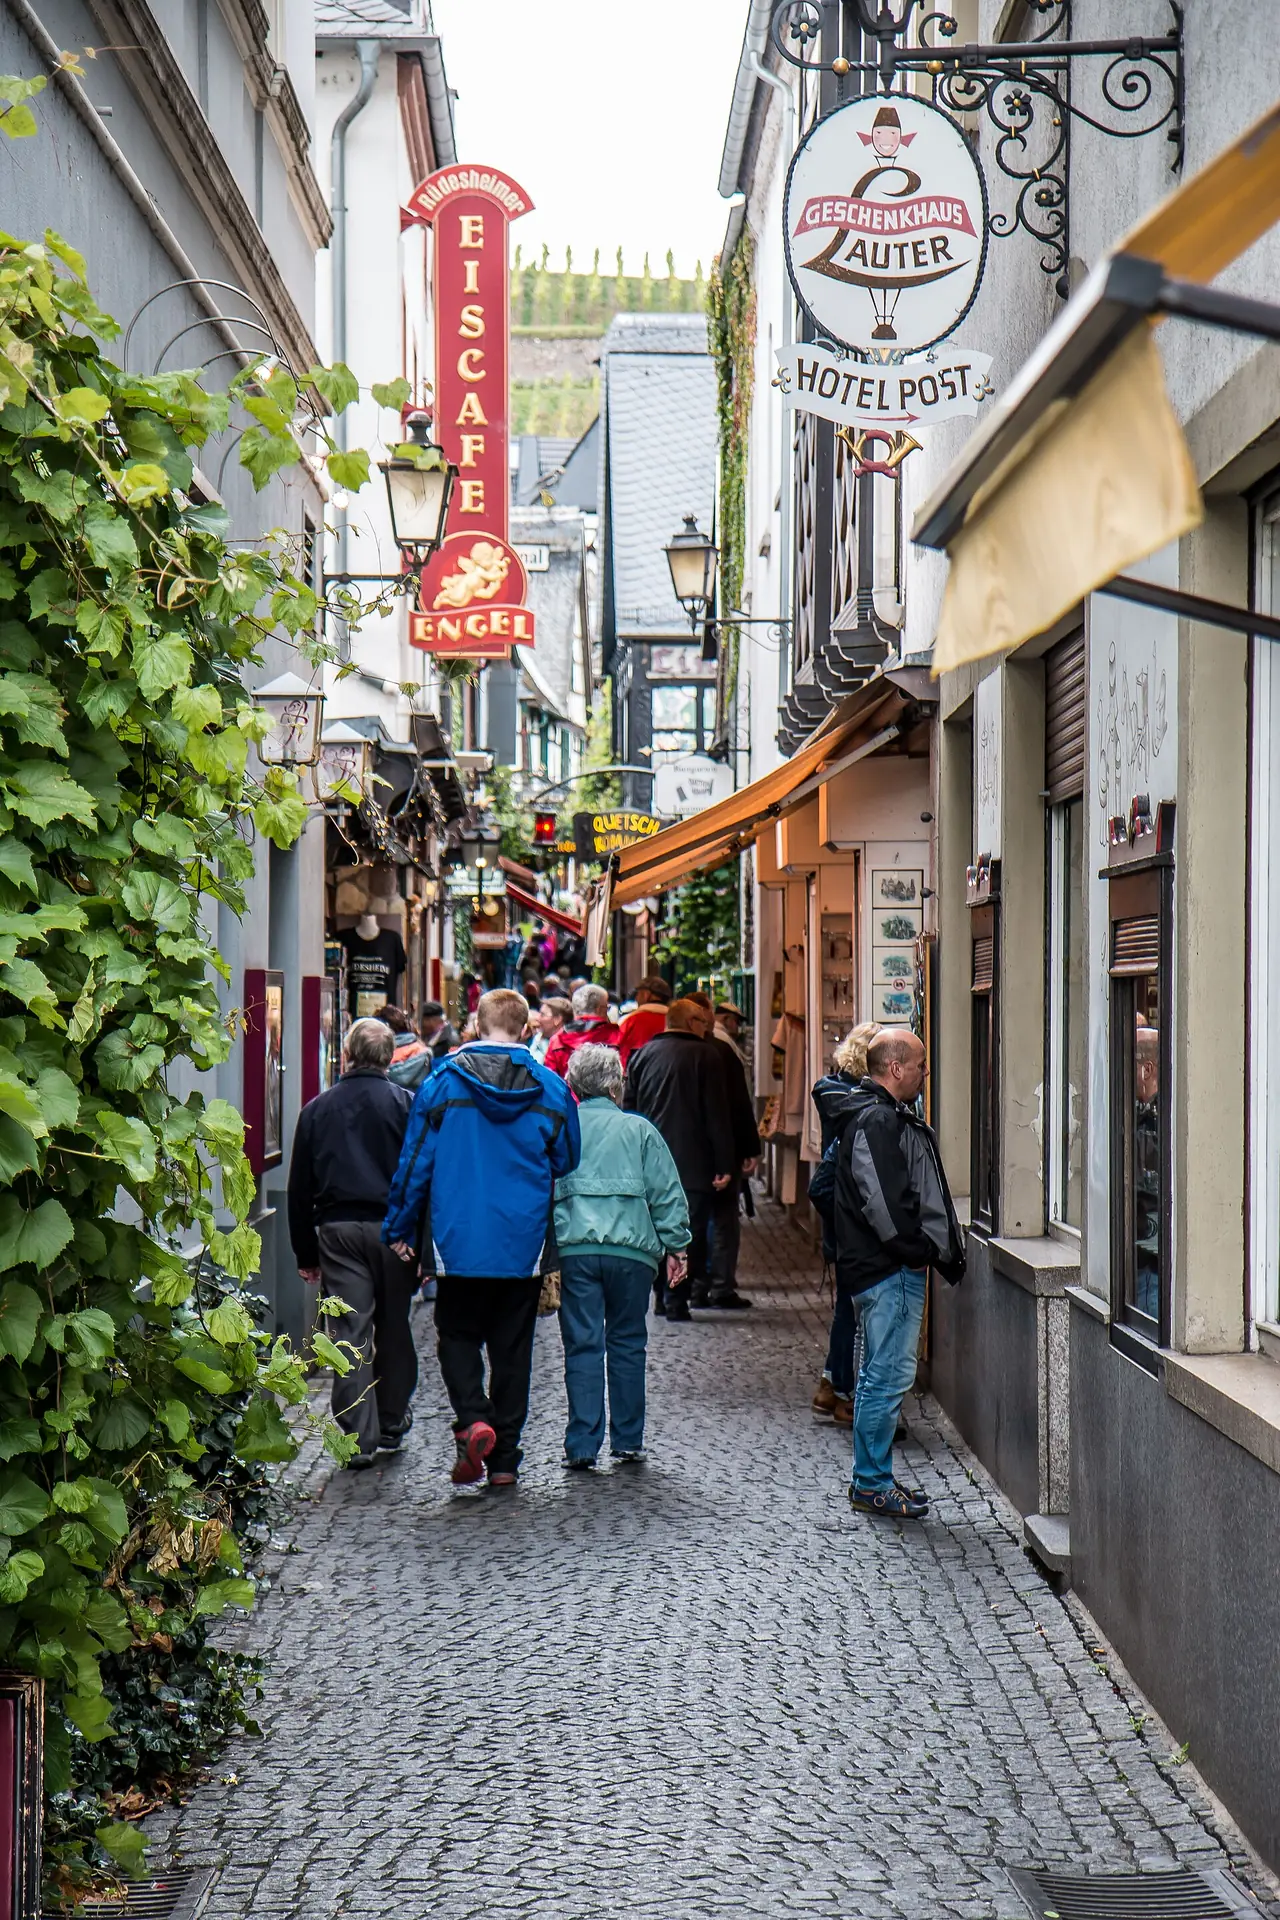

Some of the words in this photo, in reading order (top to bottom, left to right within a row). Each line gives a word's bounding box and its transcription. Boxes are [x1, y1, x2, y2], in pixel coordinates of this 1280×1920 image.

[804, 199, 964, 232] GESCHENKHAUS
[455, 214, 489, 514] EISCAFE
[796, 357, 890, 411] HOTEL
[898, 363, 973, 411] POST
[413, 610, 533, 642] ENGEL
[593, 813, 661, 835] QUETSCH
